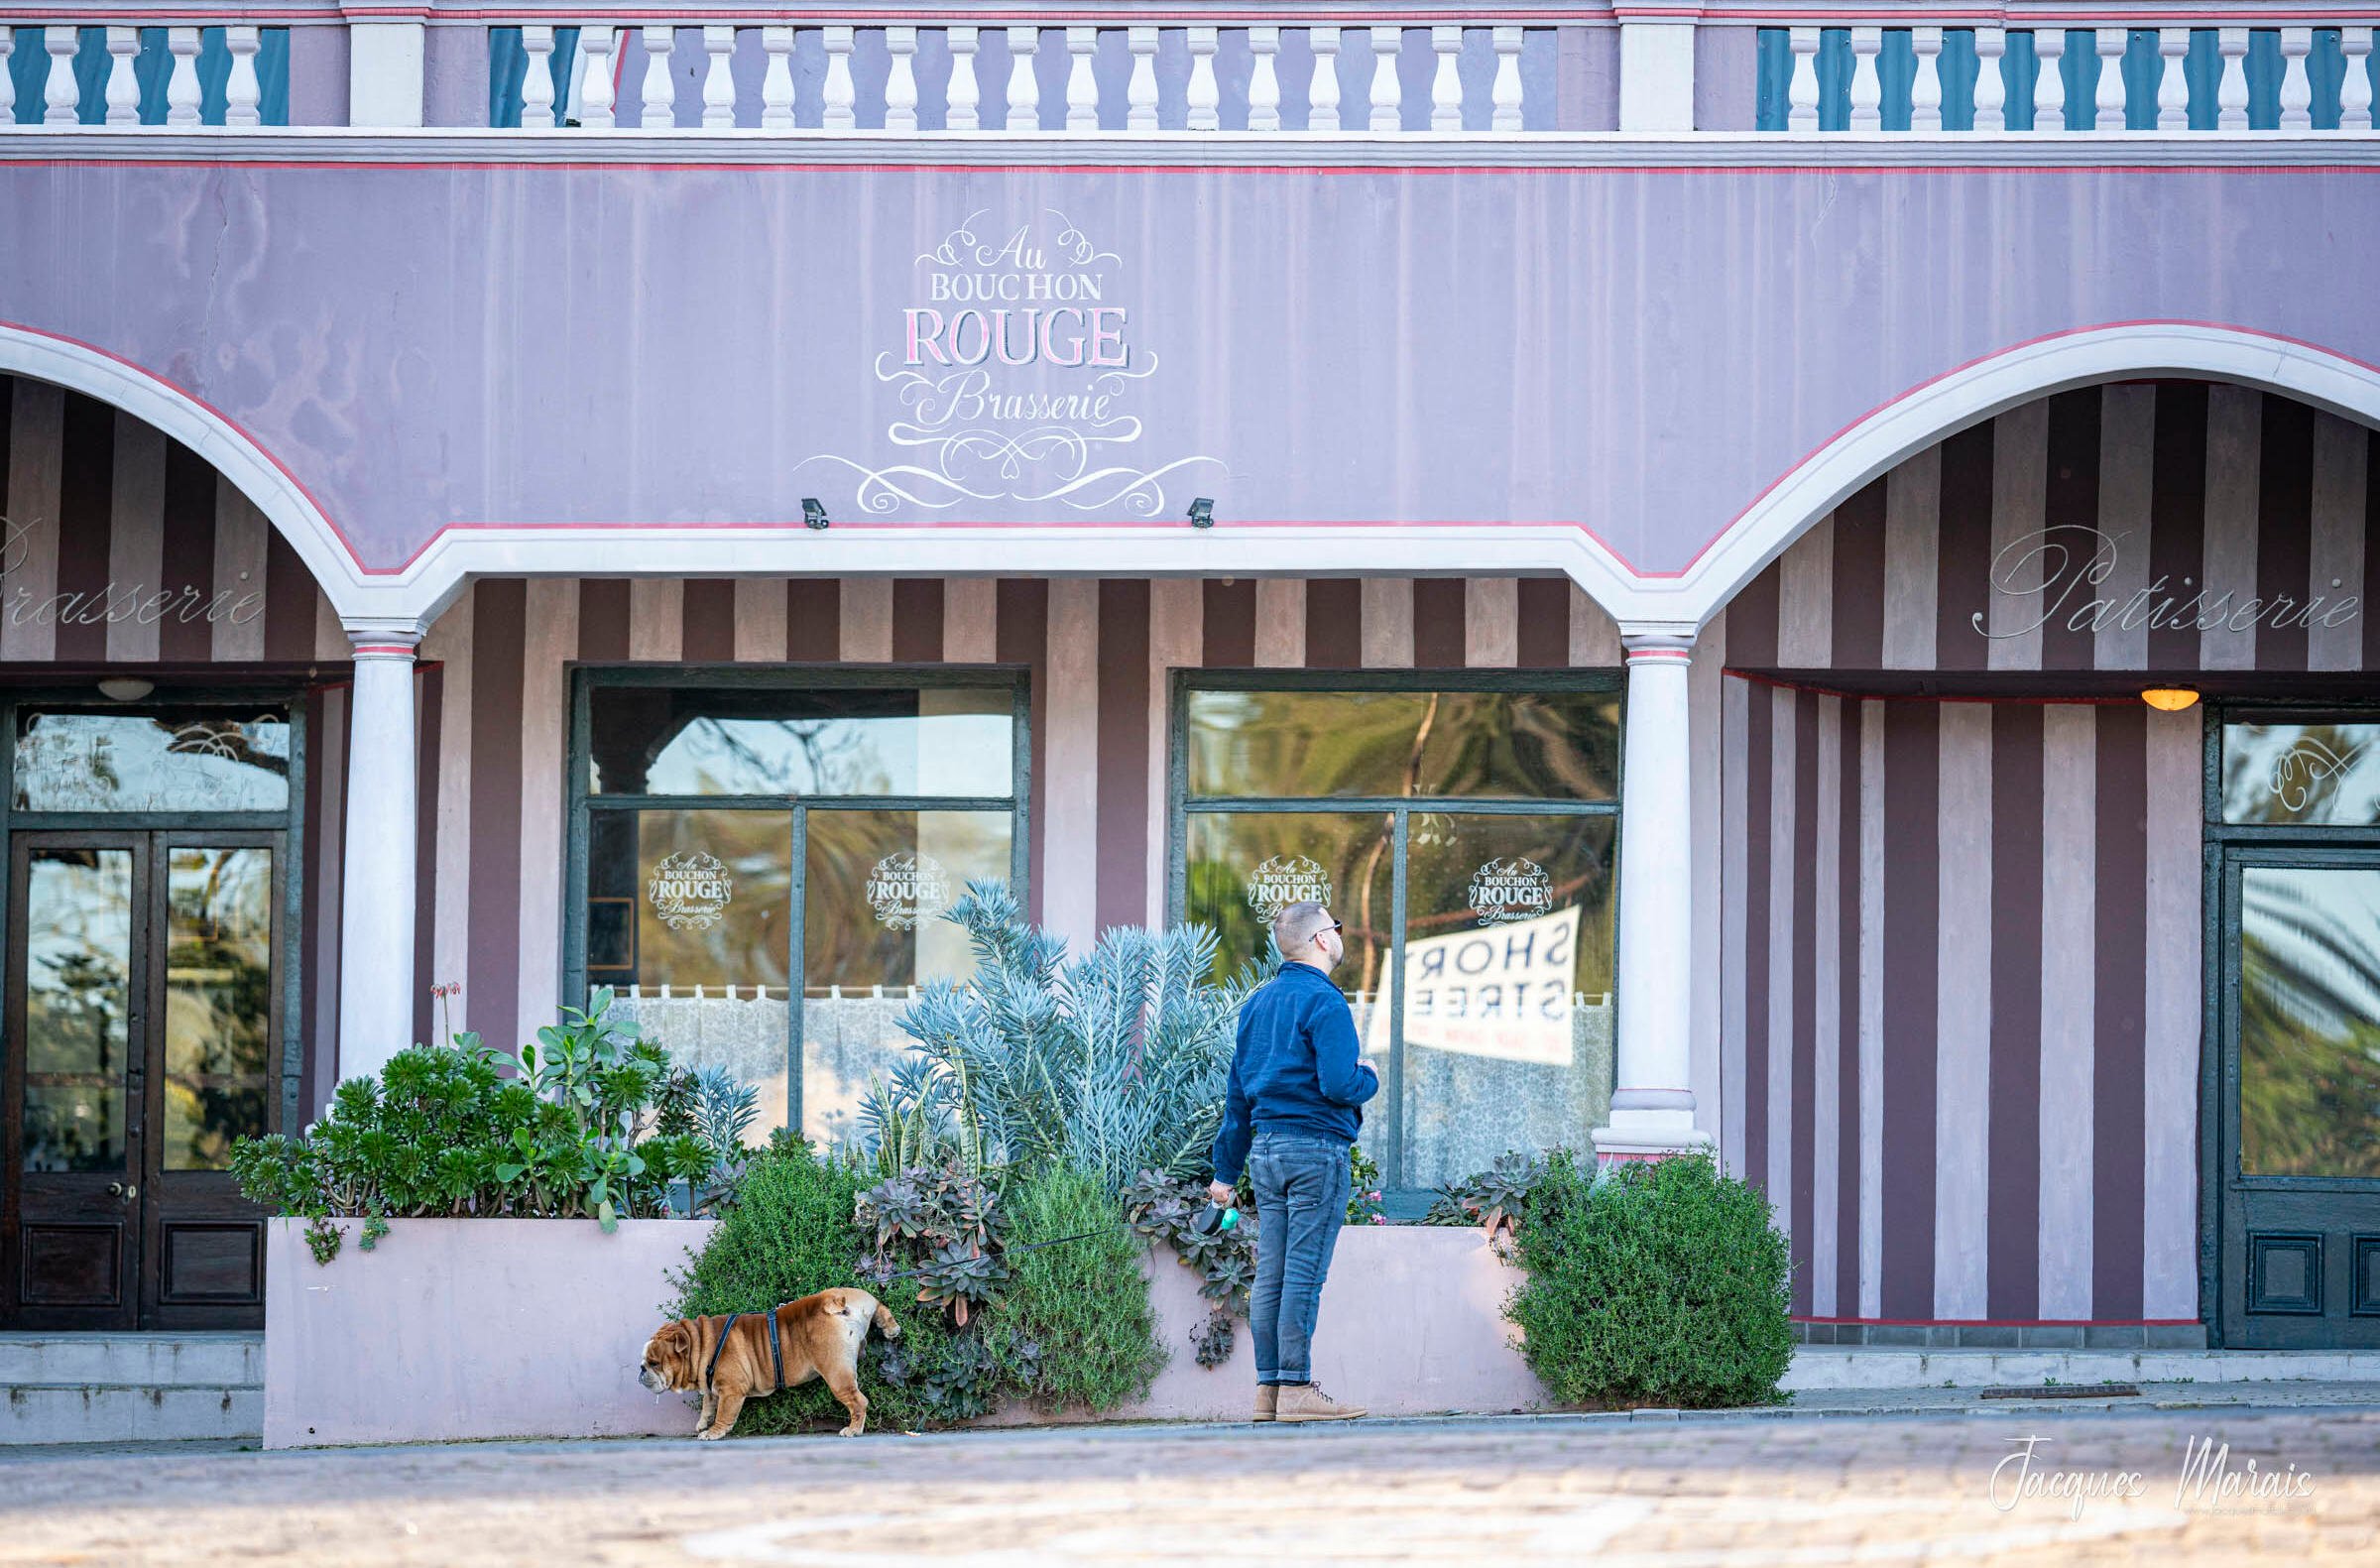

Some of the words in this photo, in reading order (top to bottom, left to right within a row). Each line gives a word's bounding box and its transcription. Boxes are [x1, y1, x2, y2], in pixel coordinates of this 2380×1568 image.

[976, 224, 1046, 270] Au
[929, 273, 1103, 302] BOUCHON
[902, 307, 1130, 368] ROUGE
[914, 369, 1112, 424] Brasserie
[1971, 525, 2359, 640] Patisserie
[664, 870, 717, 881] BOUCHON
[1275, 859, 1297, 874] Au
[1496, 862, 1518, 877] Au
[882, 871, 935, 882] BOUCHON
[1263, 874, 1317, 885] BOUCHON
[1484, 876, 1538, 887] BOUCHON
[657, 880, 723, 900] ROUGE
[876, 881, 941, 901] ROUGE
[1256, 884, 1323, 904] ROUGE
[1478, 886, 1544, 905] ROUGE
[663, 899, 716, 914] Brasserie
[1484, 905, 1538, 920] Brasserie
